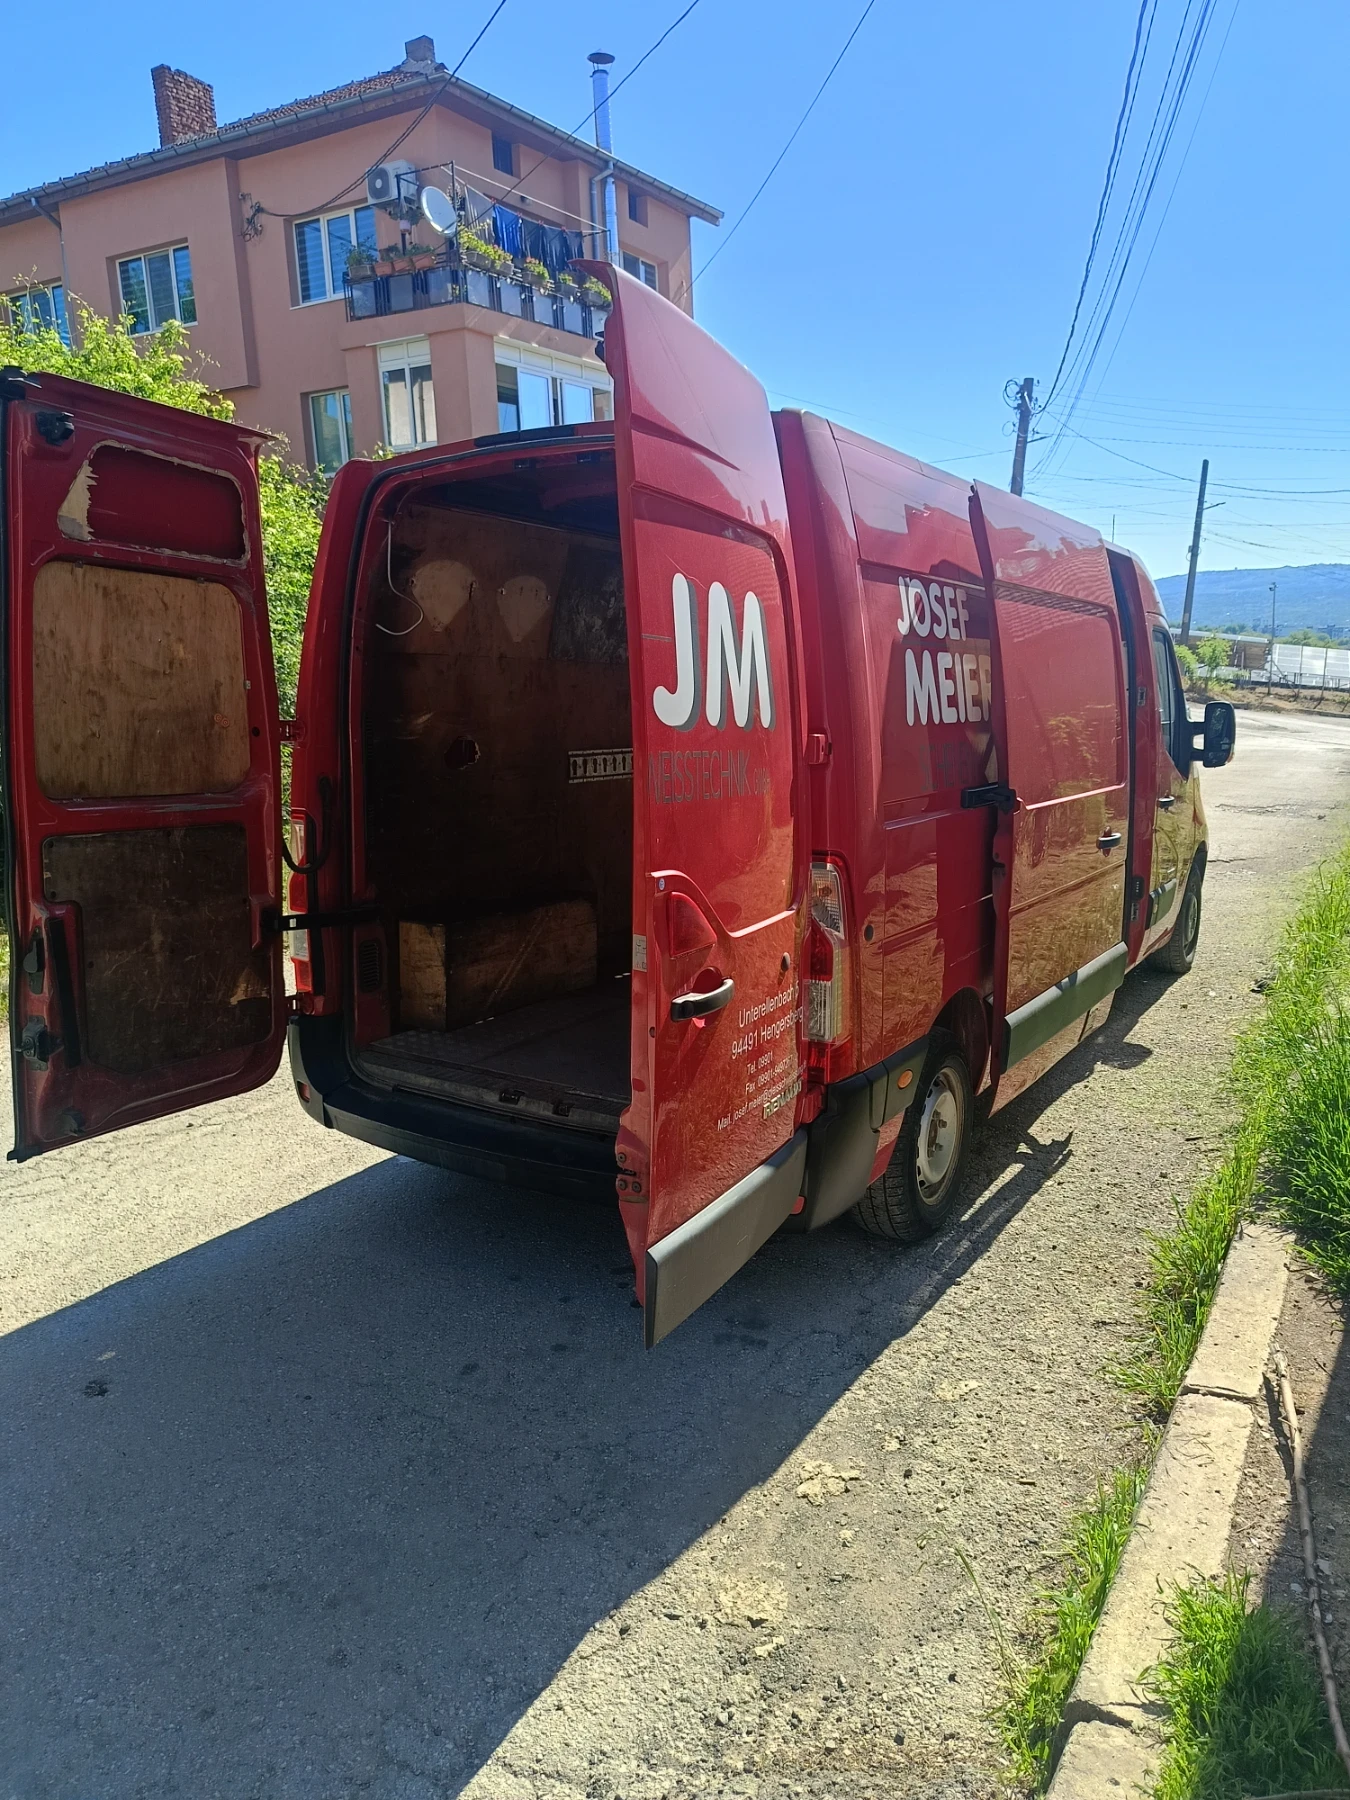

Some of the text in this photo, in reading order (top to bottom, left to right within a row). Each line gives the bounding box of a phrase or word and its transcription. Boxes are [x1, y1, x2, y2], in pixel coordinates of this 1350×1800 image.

[897, 576, 969, 641] JOSEF
[653, 573, 774, 731] JM
[905, 648, 991, 726] MEIER
[731, 1029, 758, 1060] 94491
